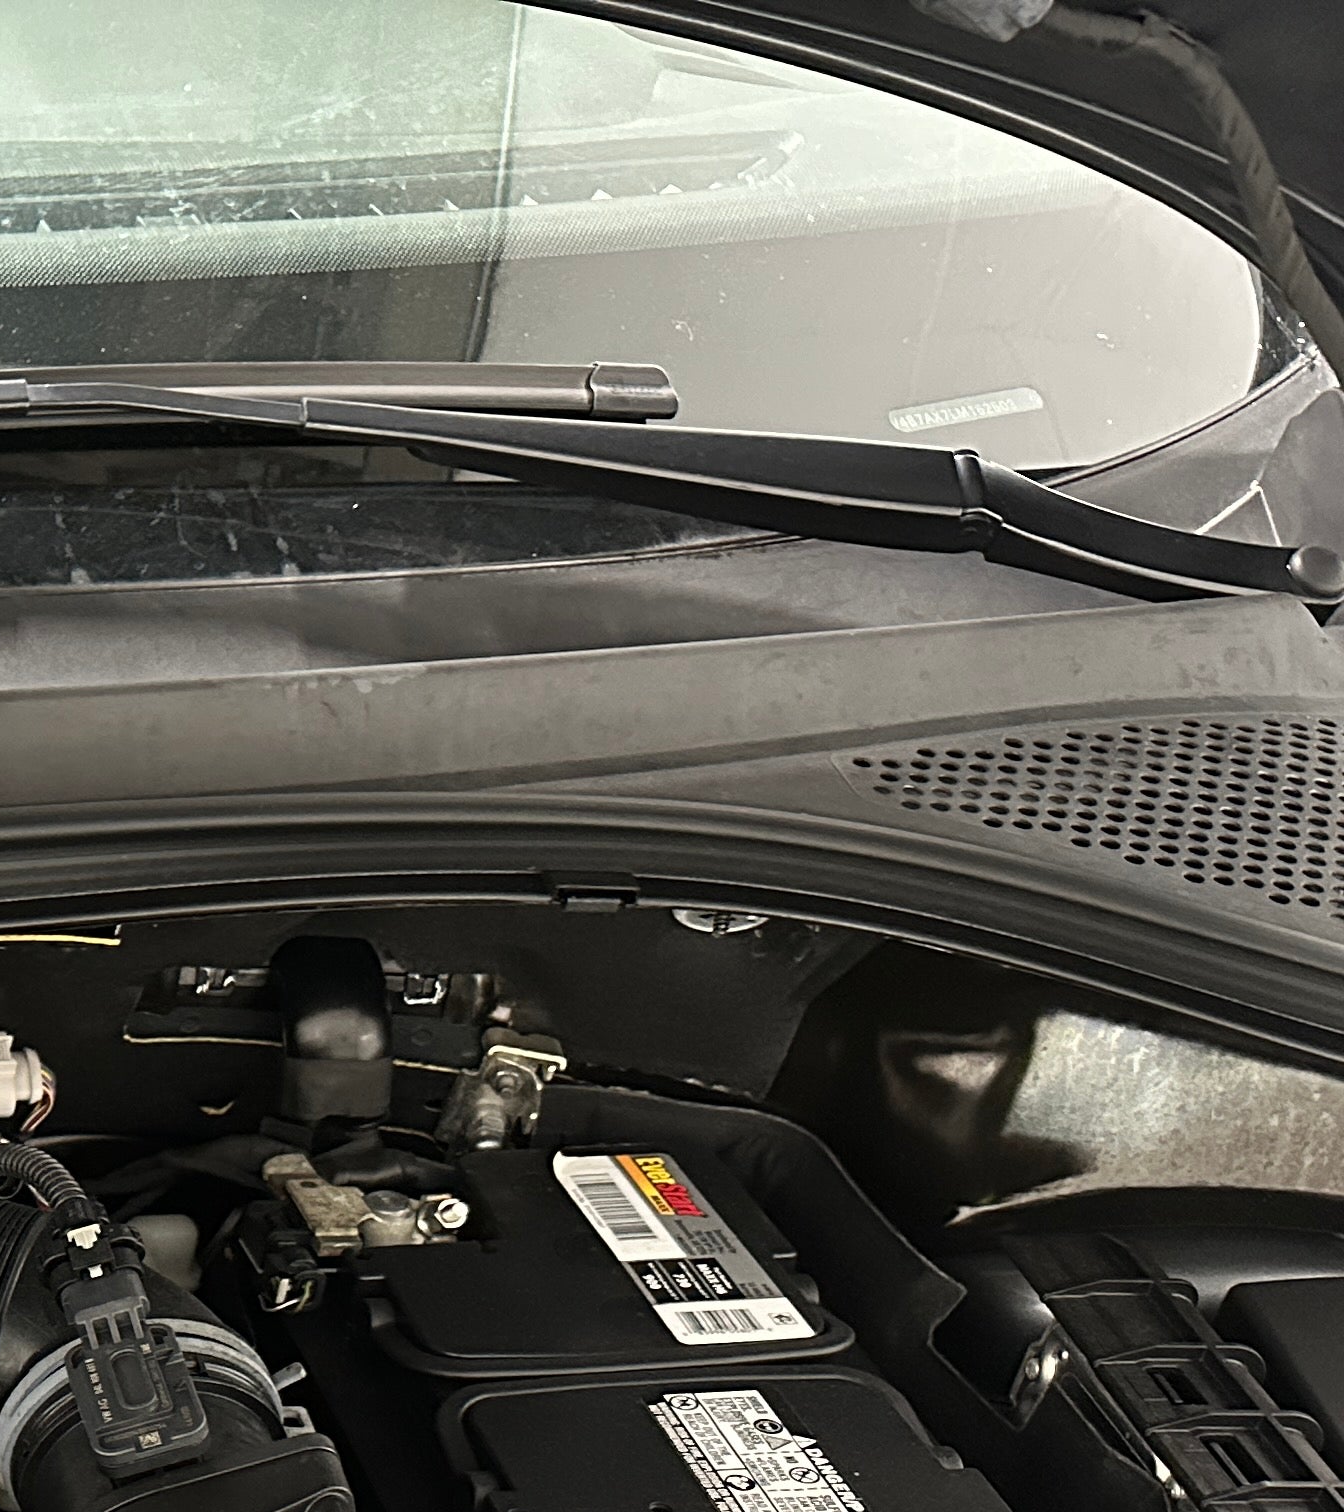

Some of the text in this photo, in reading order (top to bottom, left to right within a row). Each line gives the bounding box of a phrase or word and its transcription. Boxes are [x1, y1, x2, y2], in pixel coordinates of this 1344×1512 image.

[632, 1157, 708, 1216] EverStart
[649, 1195, 671, 1212] MAXX
[691, 1412, 710, 1425] KEEP
[748, 1493, 769, 1508] READ
[805, 1495, 828, 1511] ACID
